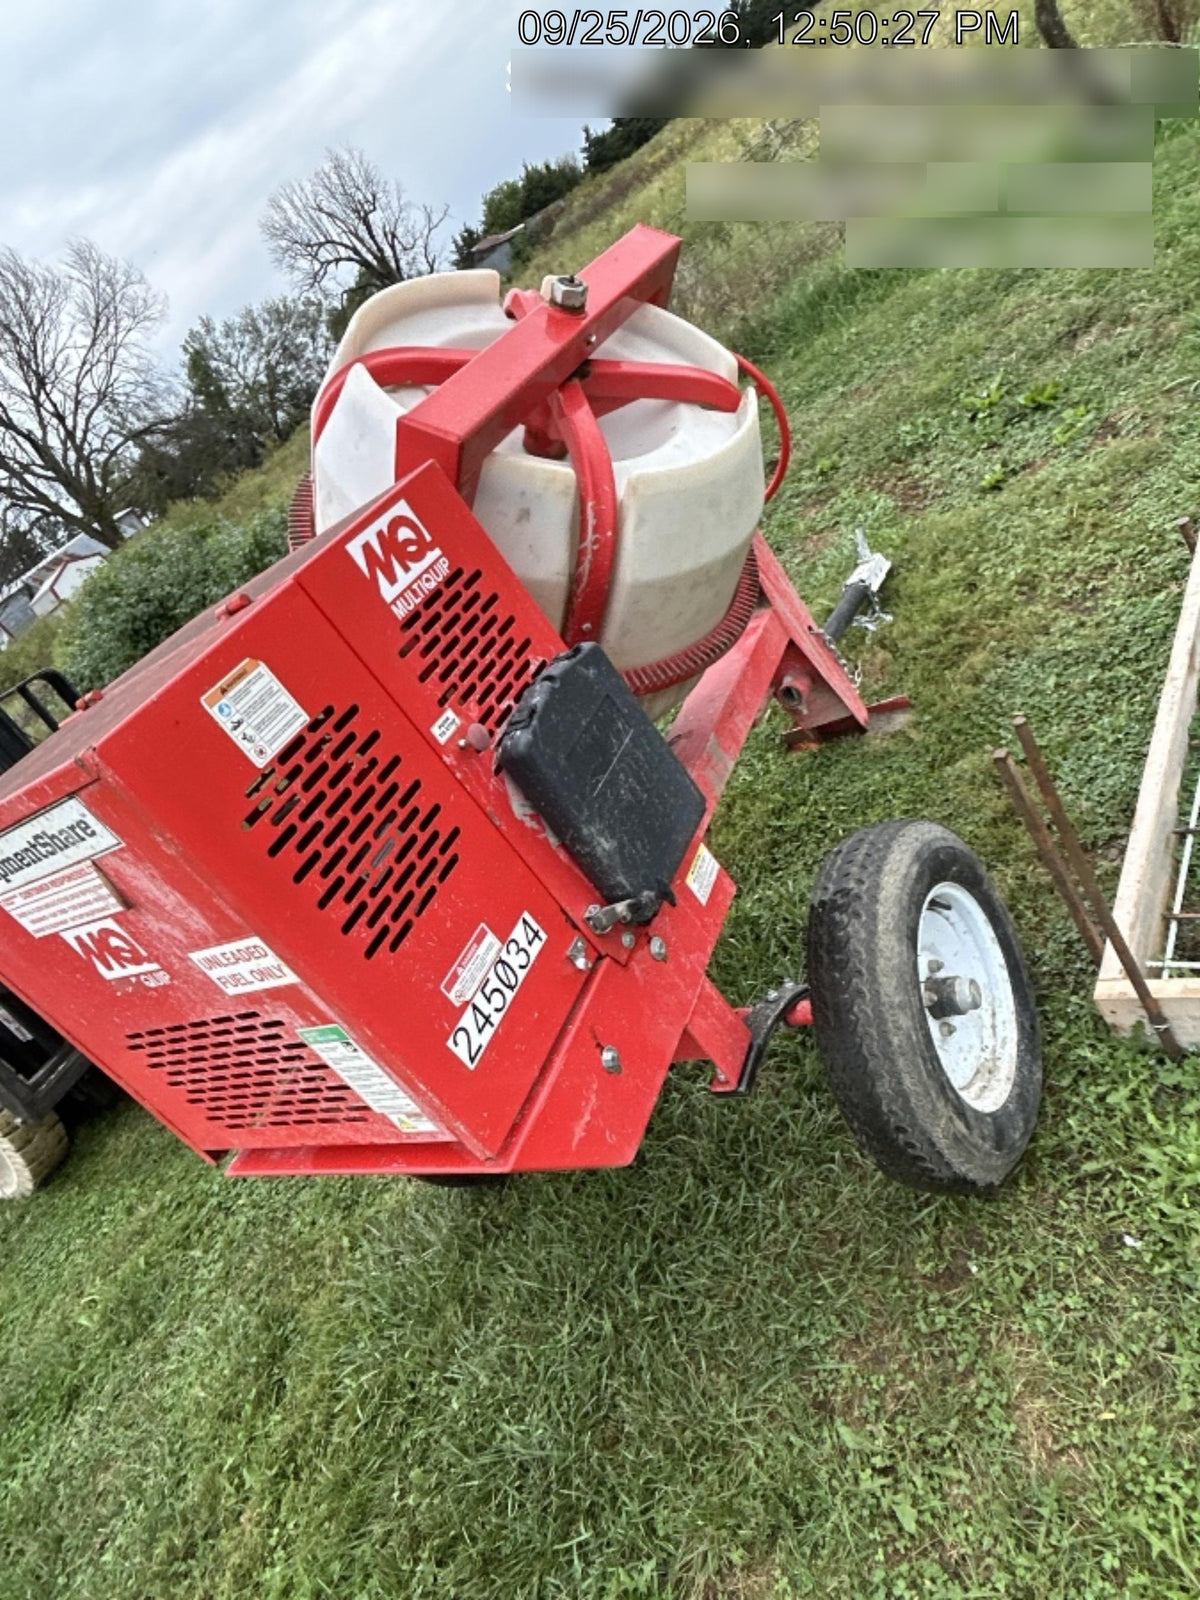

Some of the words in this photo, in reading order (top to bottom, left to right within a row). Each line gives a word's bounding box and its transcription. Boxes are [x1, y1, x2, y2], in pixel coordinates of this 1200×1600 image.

[390, 557, 450, 621] MULTIQUIP
[198, 944, 269, 971] UNLEADED
[216, 971, 255, 989] FUEL
[249, 963, 288, 982] ONLY
[452, 916, 543, 1065] 245034
